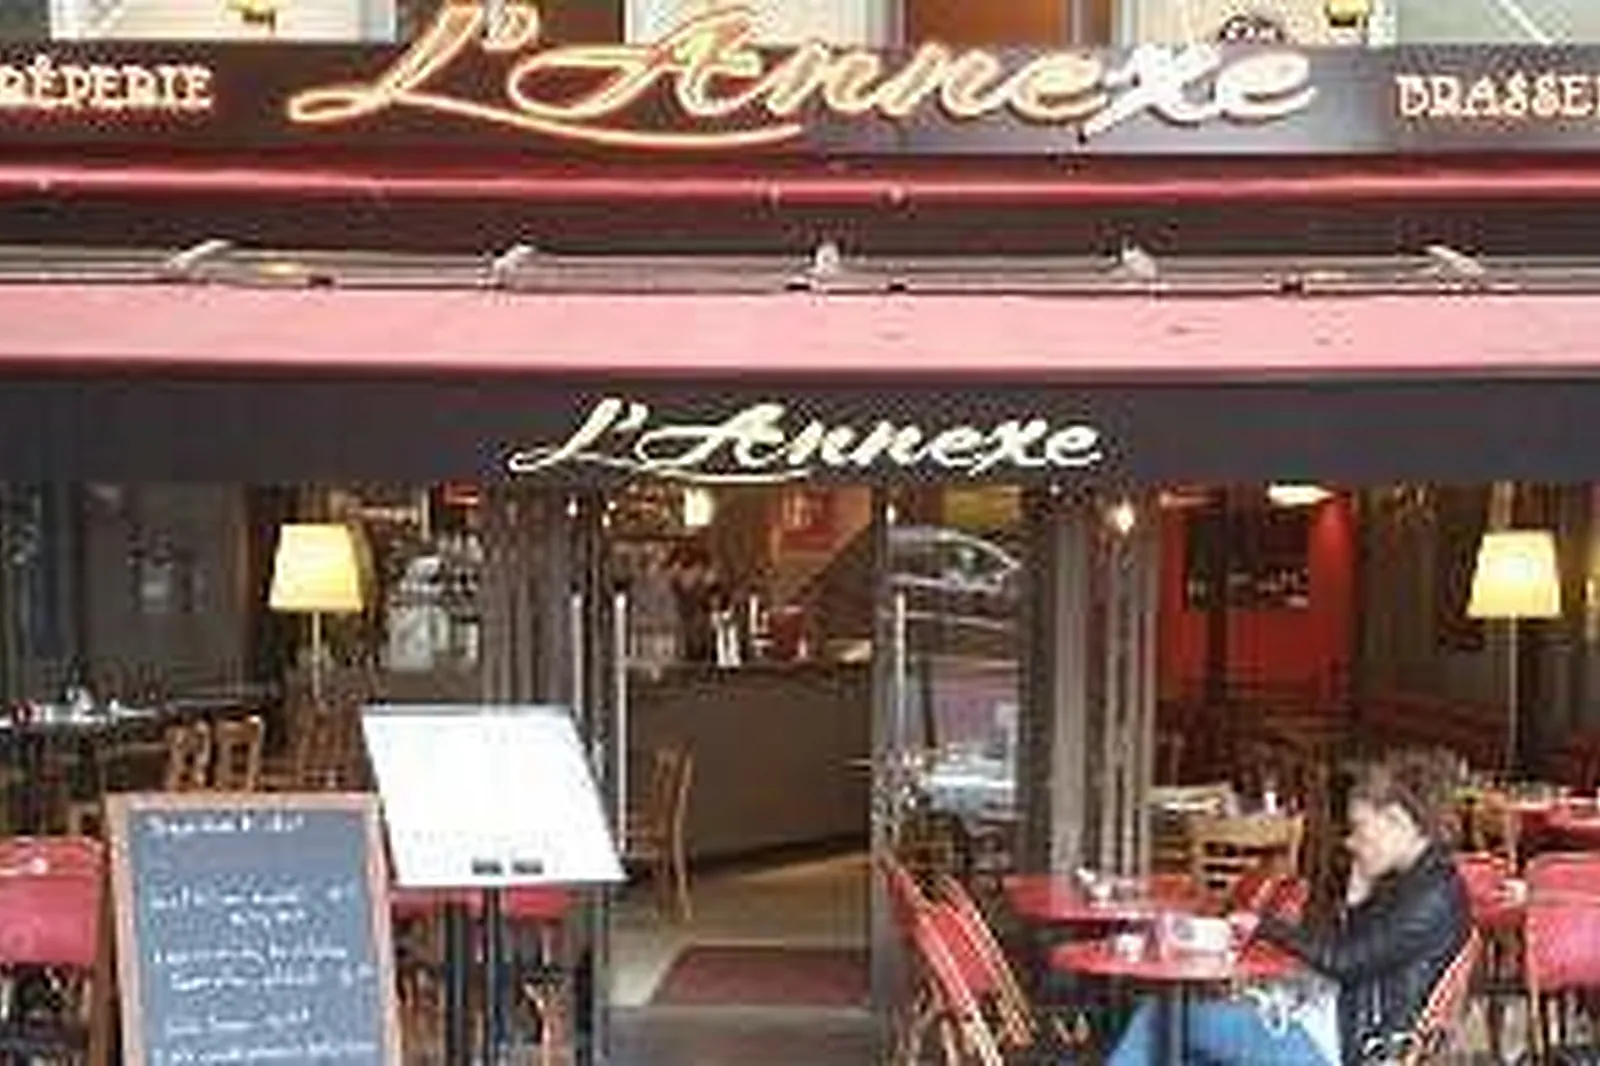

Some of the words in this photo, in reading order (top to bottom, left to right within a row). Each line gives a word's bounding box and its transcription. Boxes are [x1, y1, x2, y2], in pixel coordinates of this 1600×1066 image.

[289, 0, 1319, 148] L'Annexe
[1395, 71, 1600, 117] BRASSE
[508, 397, 1102, 483] L'Annexe
